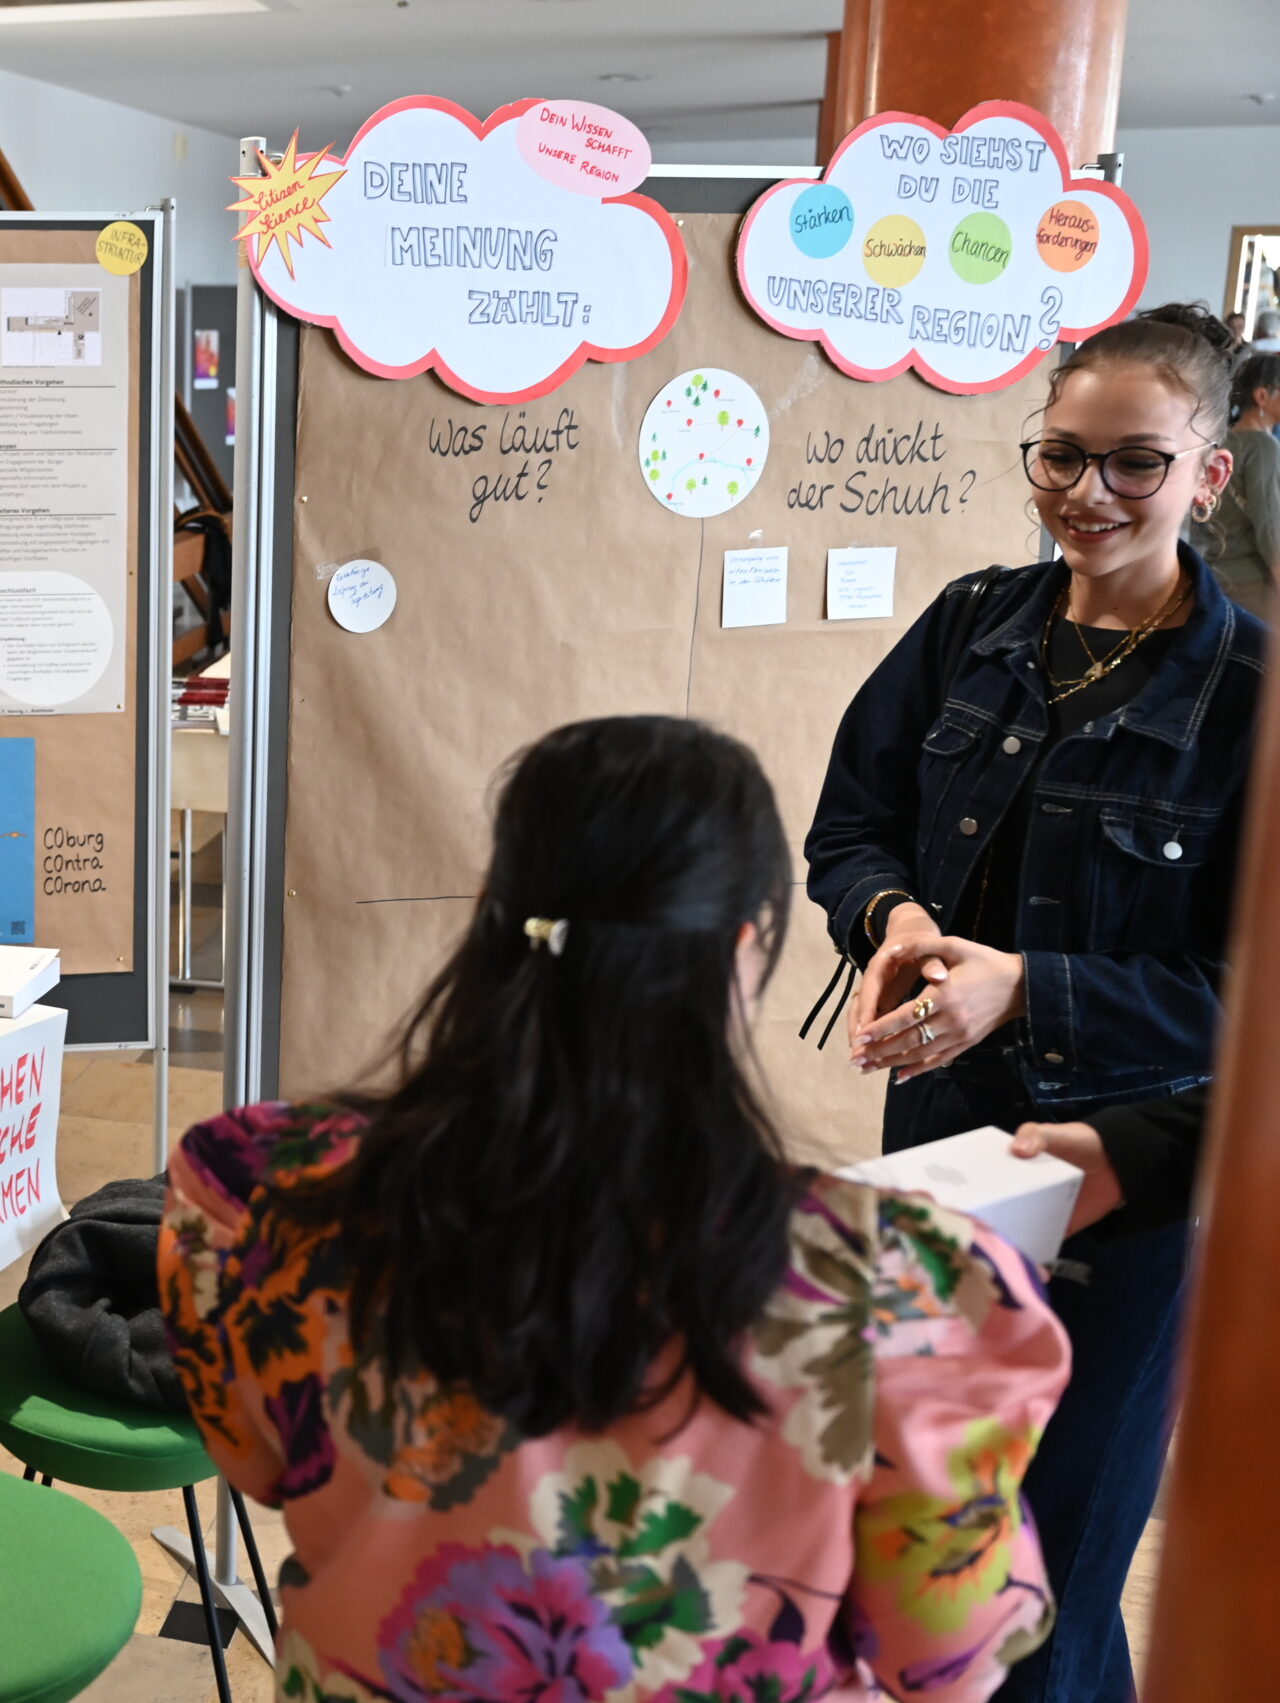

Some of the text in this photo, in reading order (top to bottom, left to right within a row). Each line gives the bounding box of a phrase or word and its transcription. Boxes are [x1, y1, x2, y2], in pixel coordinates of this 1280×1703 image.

[540, 108, 613, 139] DEIN WISSEN
[538, 143, 619, 183] UNSERE REGION
[585, 137, 632, 160] SCHAFFT
[880, 134, 1047, 173] WO SIEHST
[253, 181, 305, 211] Citizen
[363, 160, 468, 204] DEINE
[897, 174, 1000, 209] DU DIE
[259, 197, 316, 235] Science
[794, 204, 853, 234] Stärken
[1048, 207, 1095, 233] Heraus-
[98, 241, 145, 265] STRUKTUR
[111, 228, 146, 247] INFRA-
[390, 226, 557, 271] MEINUNG
[863, 238, 927, 260] Schwächen
[951, 231, 1010, 270] Chancen
[1036, 227, 1098, 261] forderungen
[468, 289, 592, 328] ZÄHLT:
[767, 276, 903, 325] UNSERER
[35, 379, 64, 387] Vorgehen
[429, 408, 580, 458] Was läuft
[806, 423, 947, 465] Wo drückt
[470, 459, 553, 523] gut?
[787, 469, 977, 516] der Schuh?
[43, 827, 105, 853] COburg
[43, 854, 104, 874] COntra
[43, 875, 107, 896] COrona
